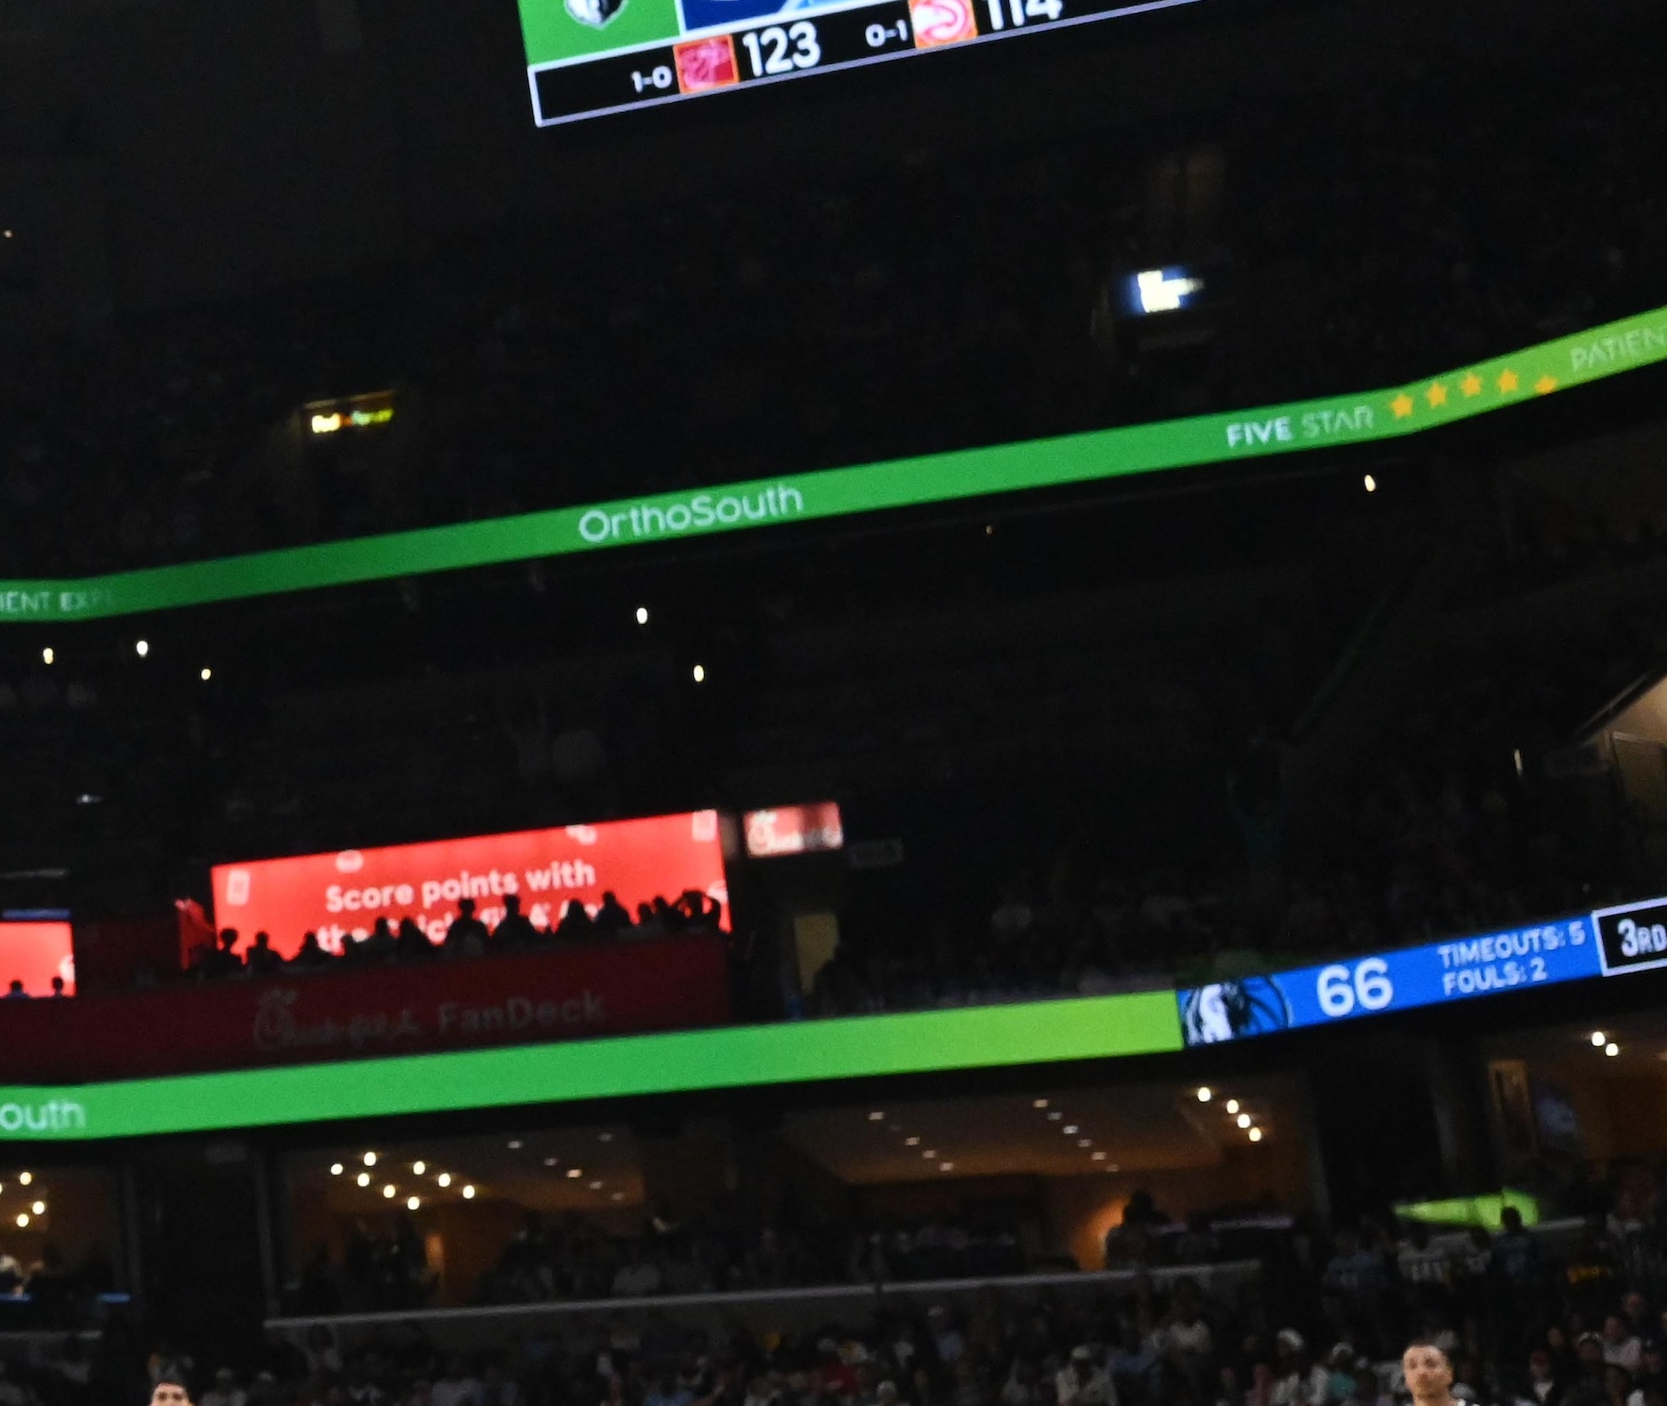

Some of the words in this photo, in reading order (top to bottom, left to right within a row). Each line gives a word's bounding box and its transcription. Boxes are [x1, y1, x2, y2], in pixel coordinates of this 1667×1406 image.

[632, 65, 672, 93] 1-0
[744, 27, 822, 77] 123
[866, 18, 909, 48] 0-1
[1225, 415, 1292, 449] FIVE
[1301, 405, 1374, 439] STAR
[1570, 327, 1667, 373] PATIEN
[579, 484, 804, 545] OrthoSouth
[324, 880, 415, 914] Score
[421, 868, 520, 910] points
[524, 858, 596, 891] with
[1437, 925, 1566, 969] TIMEOUTS:
[1568, 921, 1586, 945] 5
[1617, 918, 1667, 958] 3RD
[1317, 957, 1395, 1019] 66
[1442, 961, 1528, 996] FOULS:
[1530, 957, 1548, 982] 2
